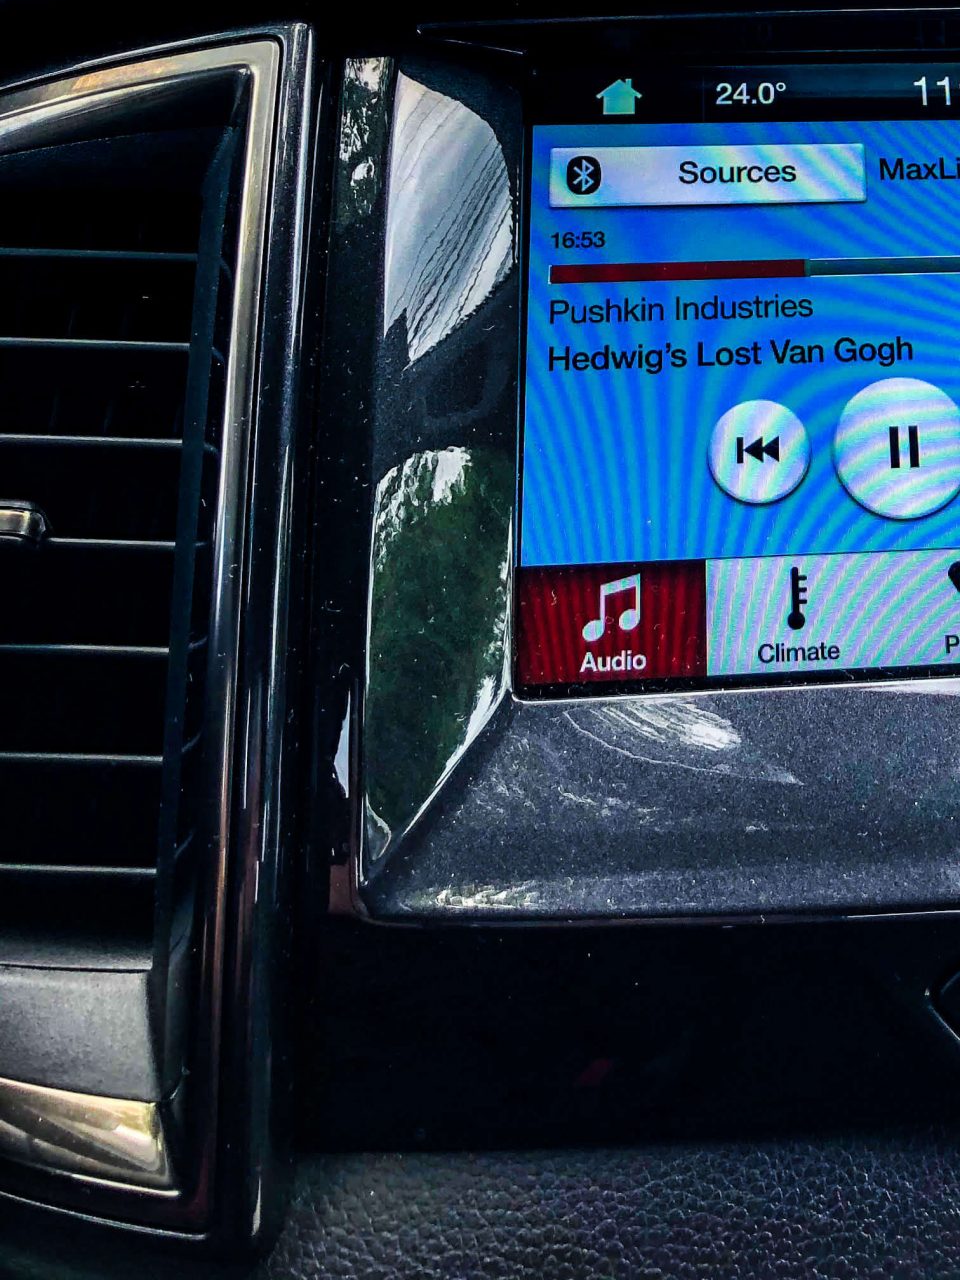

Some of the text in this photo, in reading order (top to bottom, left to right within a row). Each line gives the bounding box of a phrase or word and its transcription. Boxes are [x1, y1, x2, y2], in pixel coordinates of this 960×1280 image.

[715, 80, 787, 106] 24.0°
[678, 160, 798, 185] Sources
[549, 230, 606, 250] 16:53
[549, 294, 814, 324] Pushkin Industries
[547, 335, 914, 374] Hedwig's Lost Van Gogh
[579, 649, 647, 673] Audio
[757, 641, 840, 665] Climate
